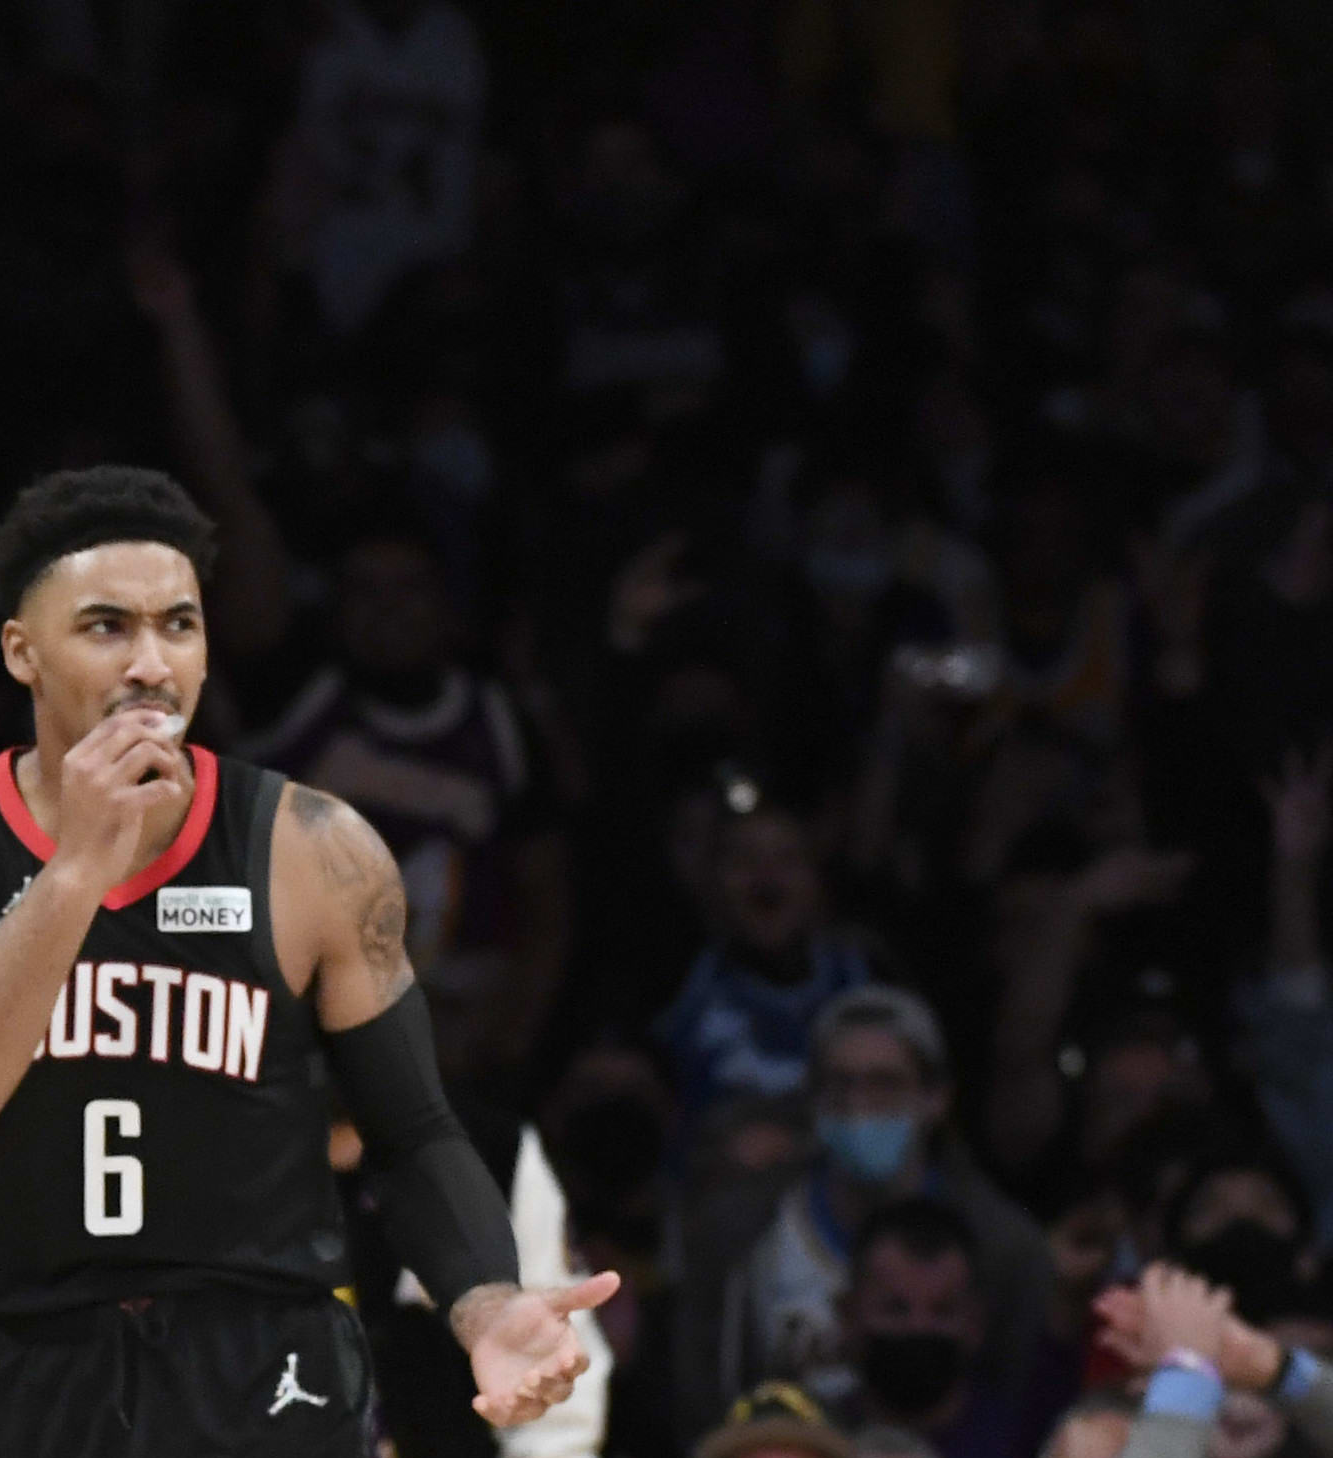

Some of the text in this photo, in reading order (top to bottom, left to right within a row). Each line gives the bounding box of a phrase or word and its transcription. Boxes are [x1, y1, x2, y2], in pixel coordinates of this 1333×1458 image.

[162, 908, 245, 926] MONEY
[32, 961, 270, 1083] USTON
[83, 1098, 144, 1237] 6
